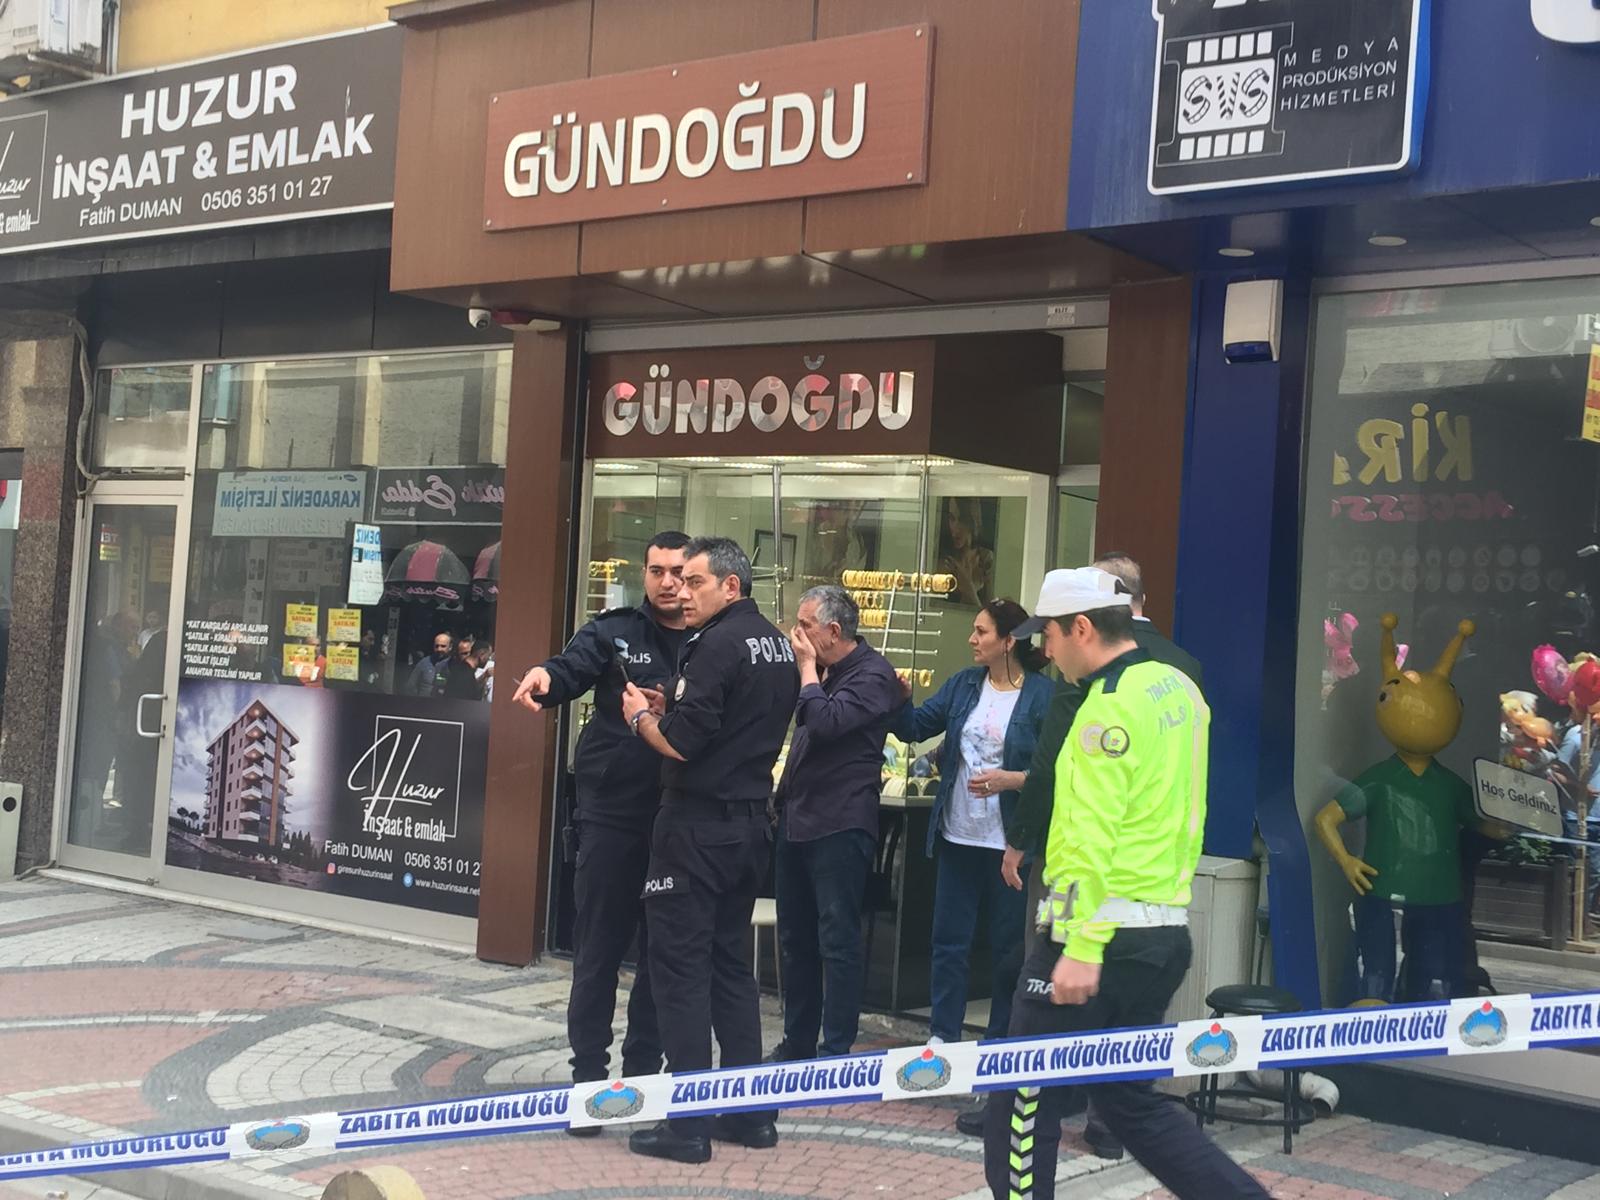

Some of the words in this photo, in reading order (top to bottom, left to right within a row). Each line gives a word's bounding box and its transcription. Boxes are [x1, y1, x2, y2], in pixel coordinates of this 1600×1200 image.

[1284, 37, 1399, 67] MEDYA
[1281, 81, 1396, 111] HİZMETLERİ
[1282, 60, 1397, 89] PRODÜKSİYON
[121, 64, 297, 138] HUZUR
[53, 145, 185, 203] İNŞAAT
[192, 141, 218, 180] &
[226, 113, 374, 174] EMLAK
[504, 81, 867, 198] GÜNDOĞDU
[80, 202, 116, 228] Fatih
[120, 197, 182, 222] DUMAN
[201, 189, 241, 212] 0506
[247, 184, 276, 206] 351
[283, 180, 301, 201] 01
[310, 175, 333, 197] 27
[603, 354, 915, 437] GÜNDOĞDU
[404, 816, 412, 838] &
[414, 818, 446, 842] emlak
[324, 840, 348, 856] Fatih
[352, 844, 392, 863] DUMAN
[404, 852, 431, 868] 0506
[433, 856, 452, 872] 351
[456, 859, 469, 875] 01
[472, 862, 482, 876] 2
[1026, 978, 1056, 995] TRA
[1261, 1024, 1327, 1053] ZABITA
[1331, 1011, 1447, 1048] MÜDÜRLÜĞÜ
[1531, 1003, 1592, 1032] ZABITA
[976, 1045, 1046, 1076] ZABITA
[1050, 1032, 1174, 1071] MÜDÜRLÜĞÜ
[671, 1076, 746, 1104] ZABITA
[751, 1060, 883, 1097] MÜDÜRLÜĞÜ
[340, 1108, 422, 1135] ZABITA
[430, 1091, 570, 1128] MÜDÜRLÜĞÜ
